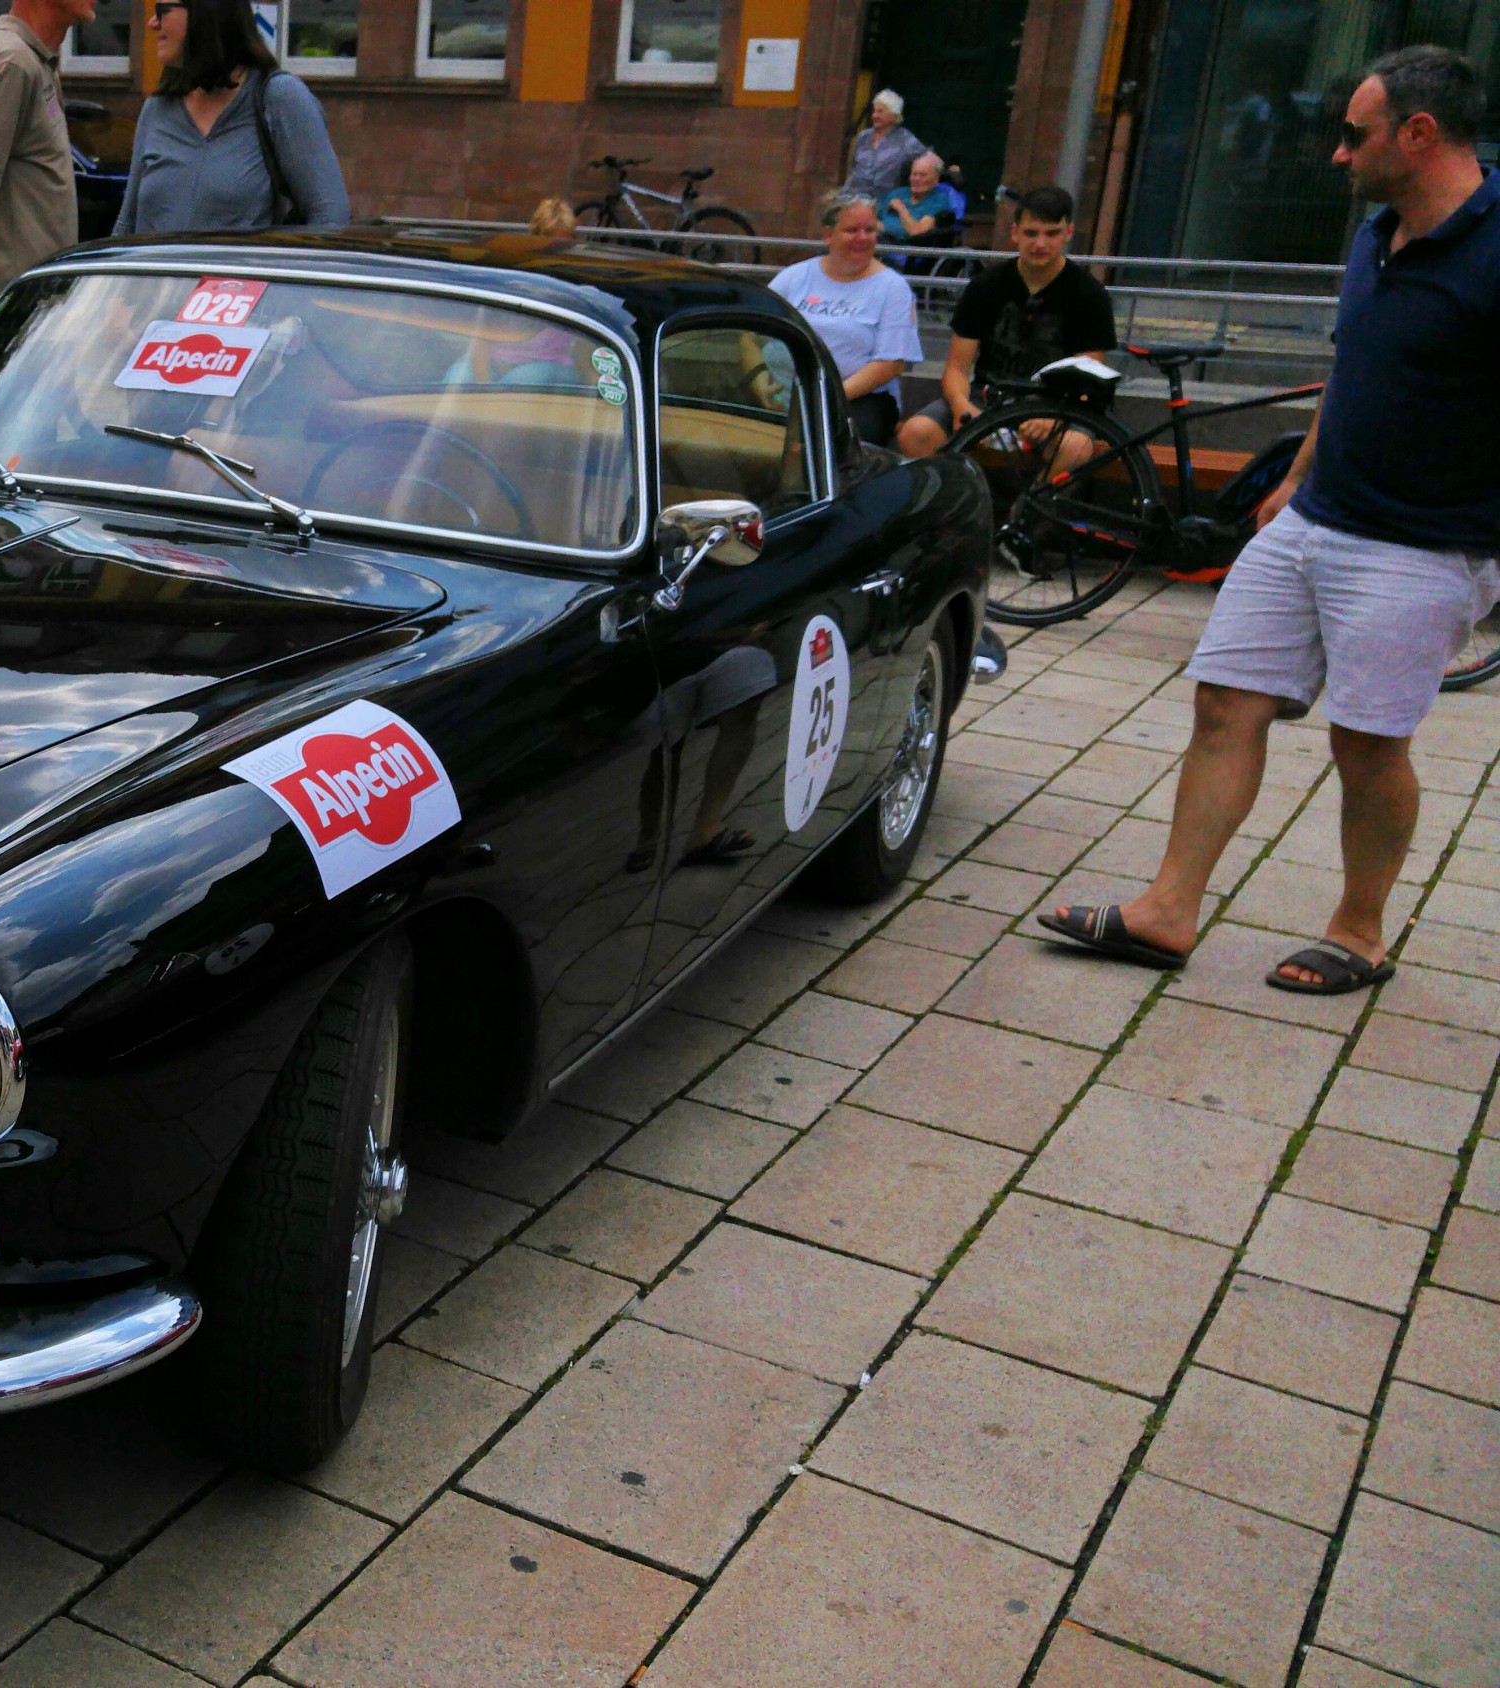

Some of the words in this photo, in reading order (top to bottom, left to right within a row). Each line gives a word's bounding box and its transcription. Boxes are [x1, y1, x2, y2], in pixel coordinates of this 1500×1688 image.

[182, 291, 255, 324] 025
[144, 345, 238, 373] Alpecin
[805, 677, 835, 759] 25
[300, 741, 423, 828] Alpecin
